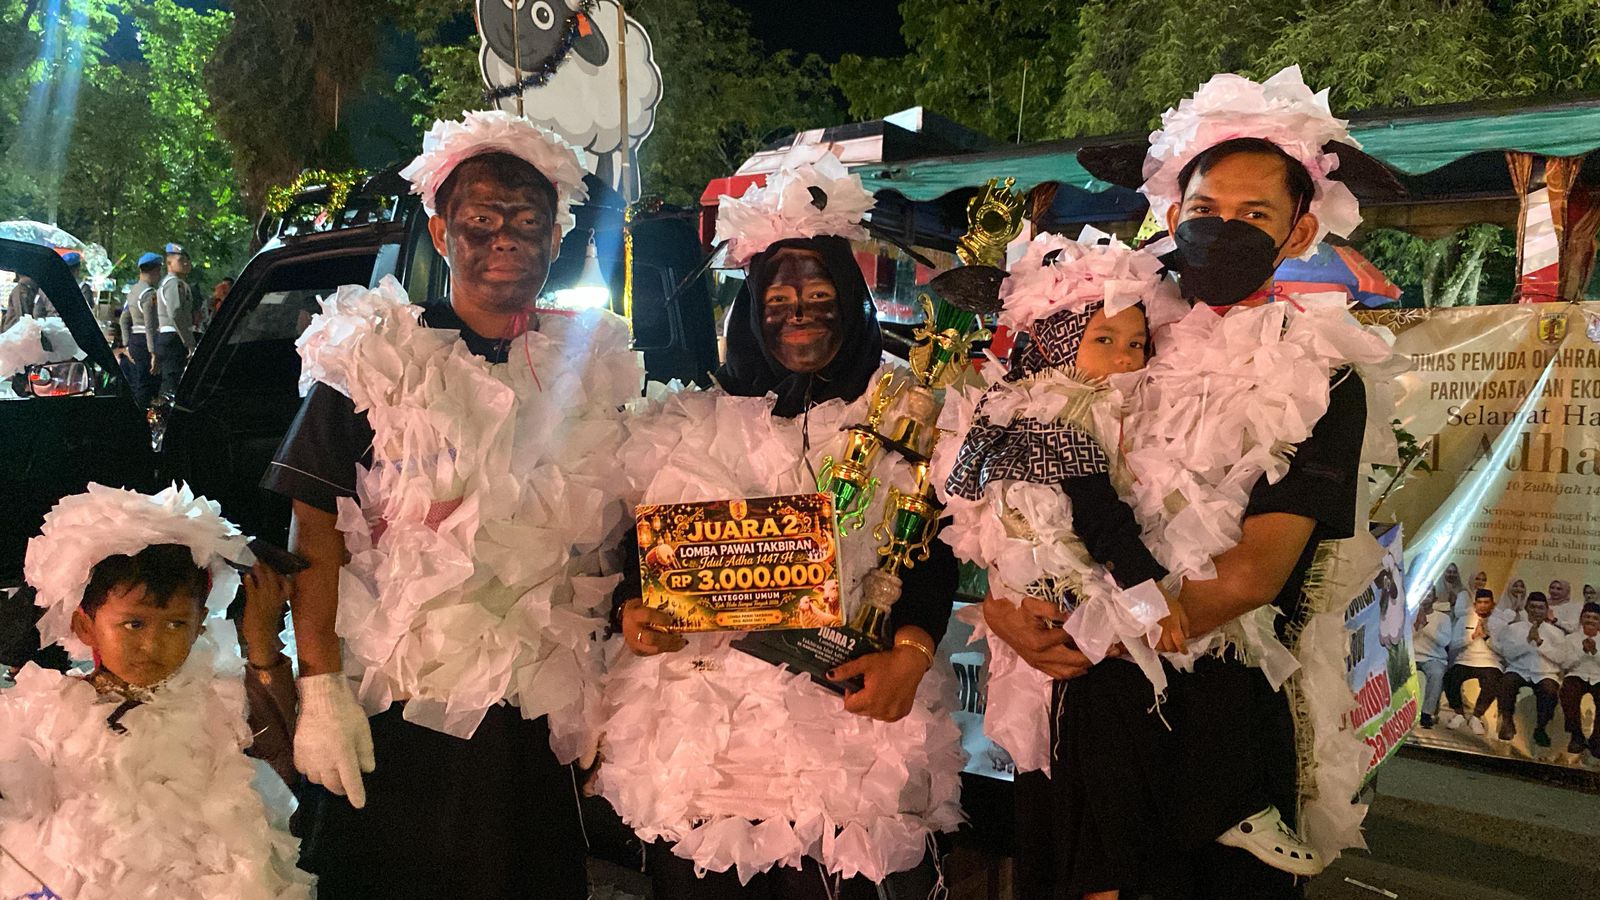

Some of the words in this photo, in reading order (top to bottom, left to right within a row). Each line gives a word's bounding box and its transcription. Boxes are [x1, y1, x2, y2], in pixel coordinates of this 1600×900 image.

[1411, 352, 1456, 371] DINAS
[1462, 350, 1526, 371] PEMUDA
[1532, 347, 1600, 369] OLAHRA
[1430, 380, 1526, 401] PARIWISATA
[1533, 378, 1564, 398] AN
[687, 517, 782, 541] JUARA
[782, 514, 799, 536] 2
[680, 545, 718, 558] LOMBA
[720, 542, 755, 556] PAWAI
[756, 539, 812, 553] TAKBIRAN
[699, 555, 724, 569] Idul
[724, 554, 754, 567] Adha
[756, 553, 780, 565] 1447
[780, 551, 795, 564] H
[671, 574, 693, 589] RP
[697, 563, 825, 590] 3.000.000
[712, 593, 753, 602] KATEGORI
[754, 591, 781, 601] UMUM
[818, 626, 849, 648] JUARA
[847, 638, 857, 651] 2
